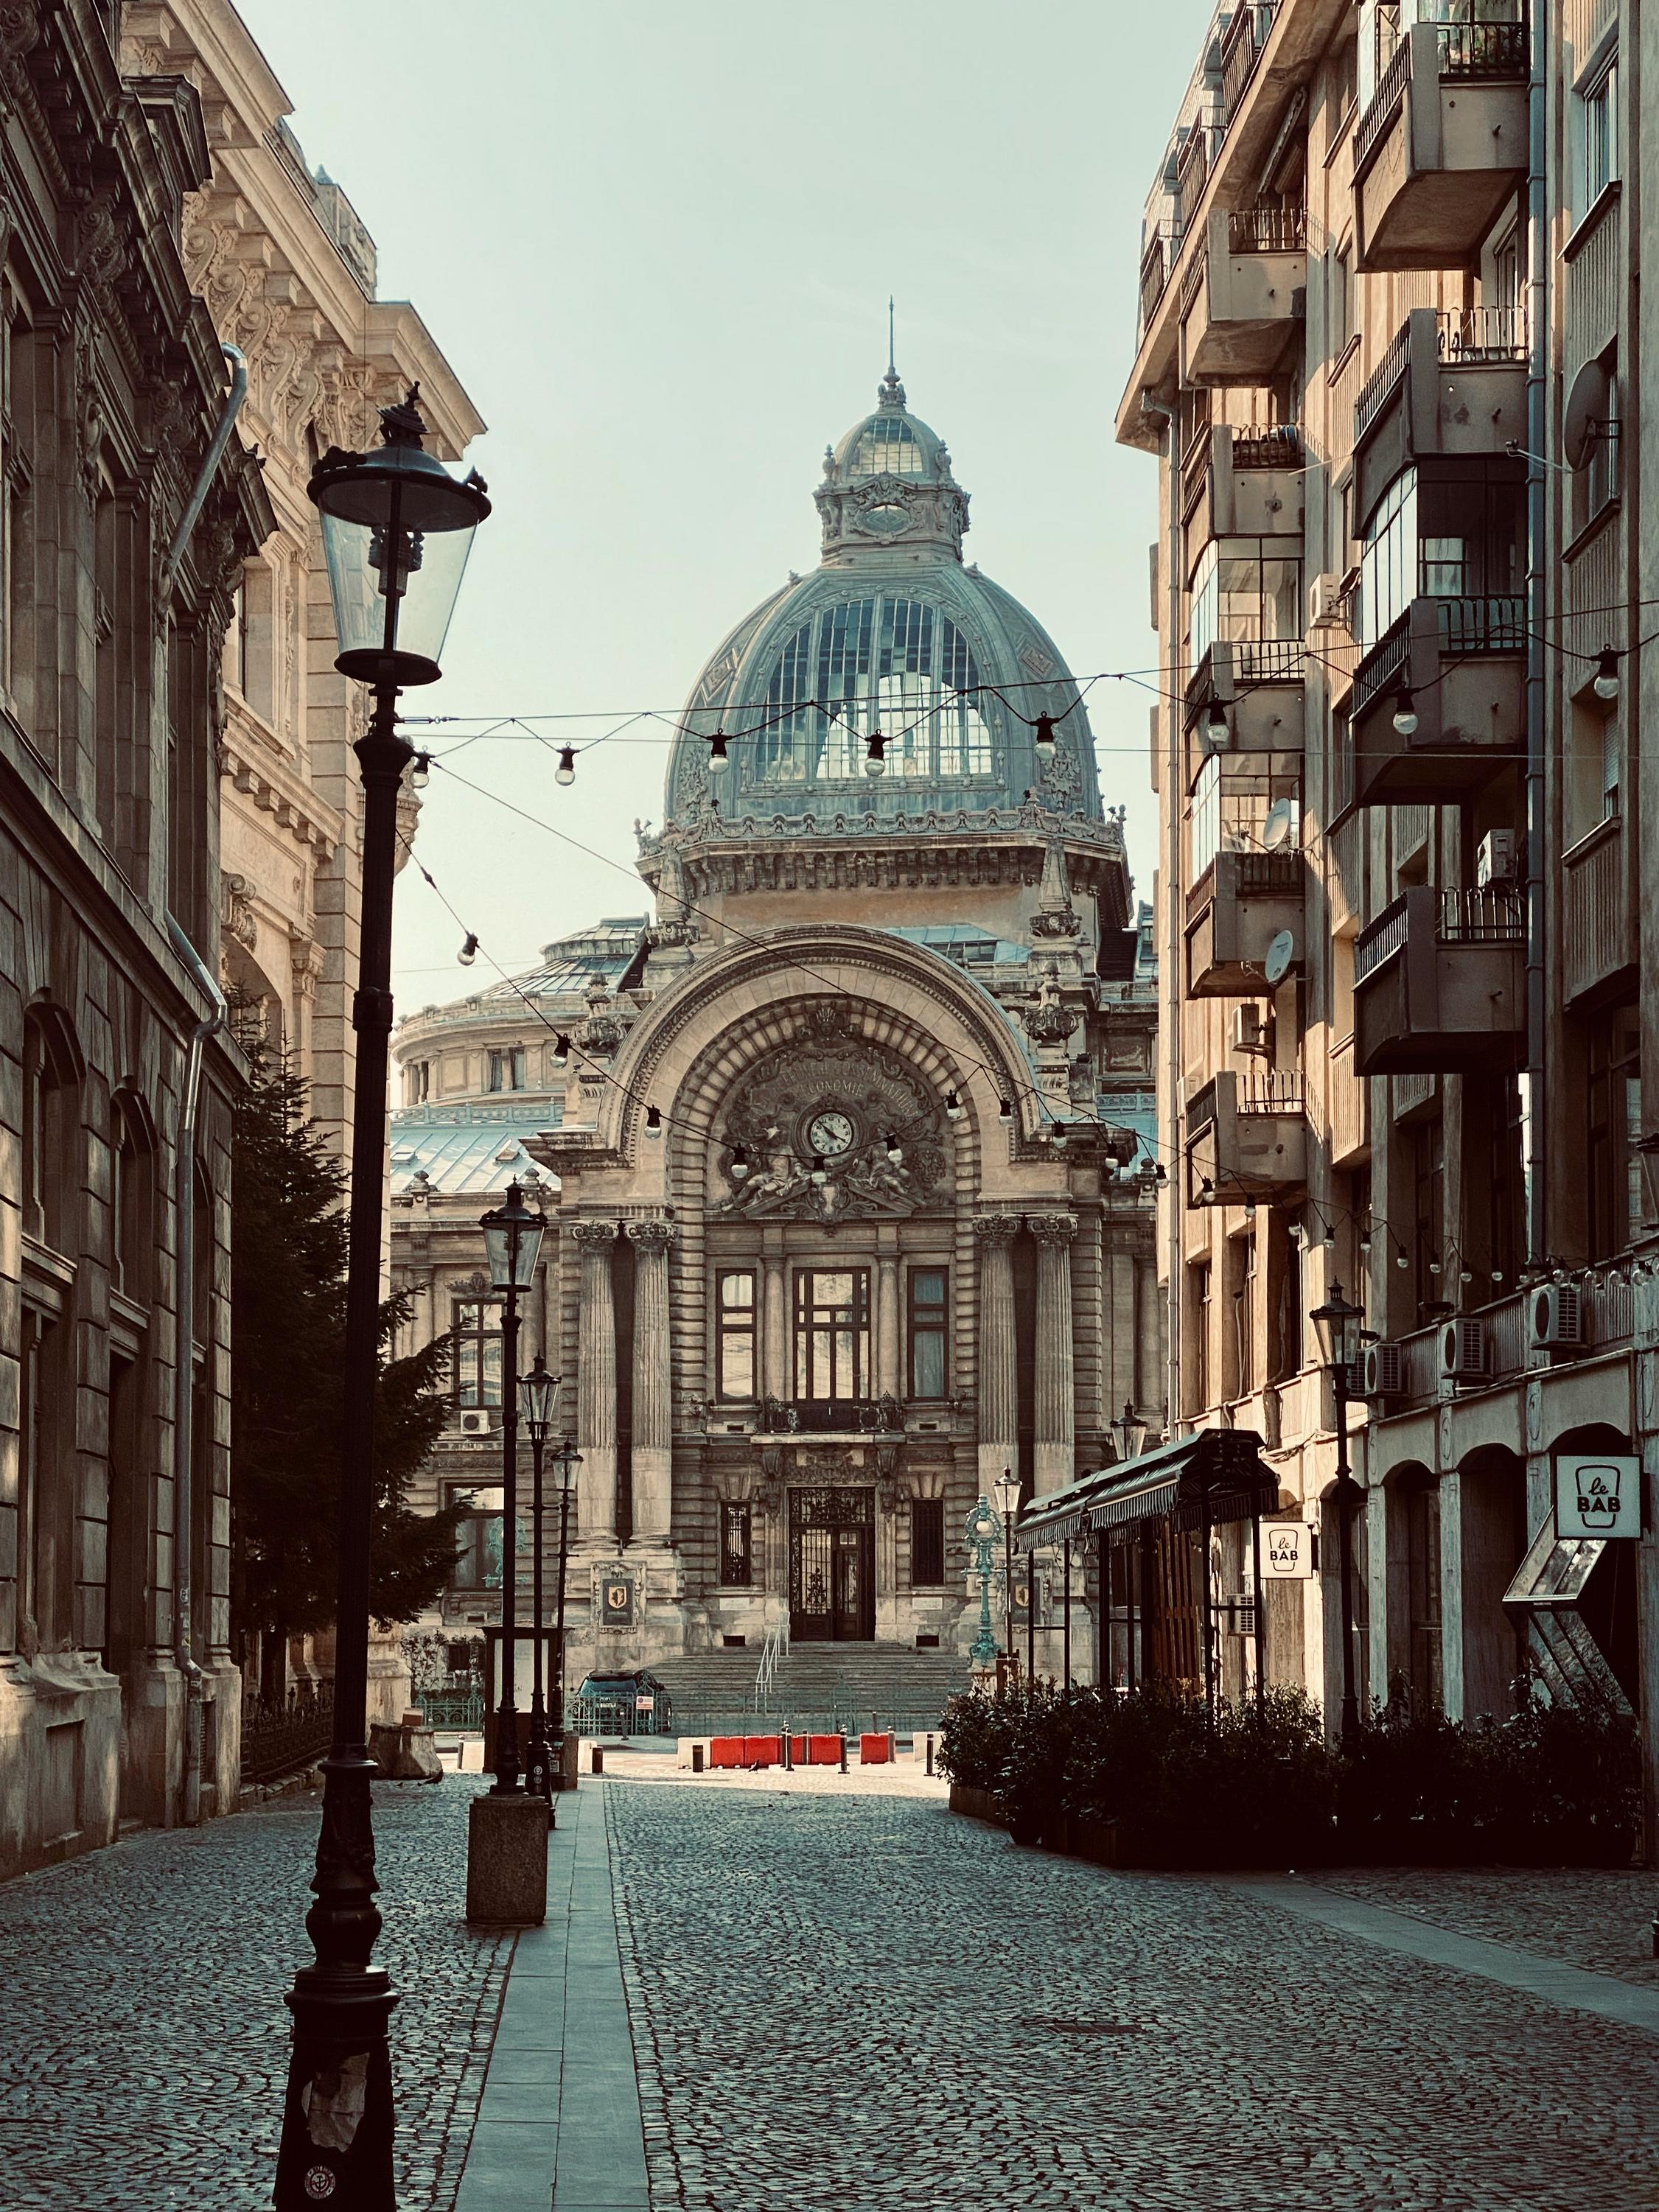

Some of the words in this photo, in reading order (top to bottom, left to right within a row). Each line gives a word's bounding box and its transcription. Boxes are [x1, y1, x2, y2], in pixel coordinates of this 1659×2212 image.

[1588, 1477, 1609, 1495] le
[1577, 1497, 1621, 1513] BAB
[1277, 1536, 1290, 1550] le
[1270, 1550, 1299, 1561] BAB
